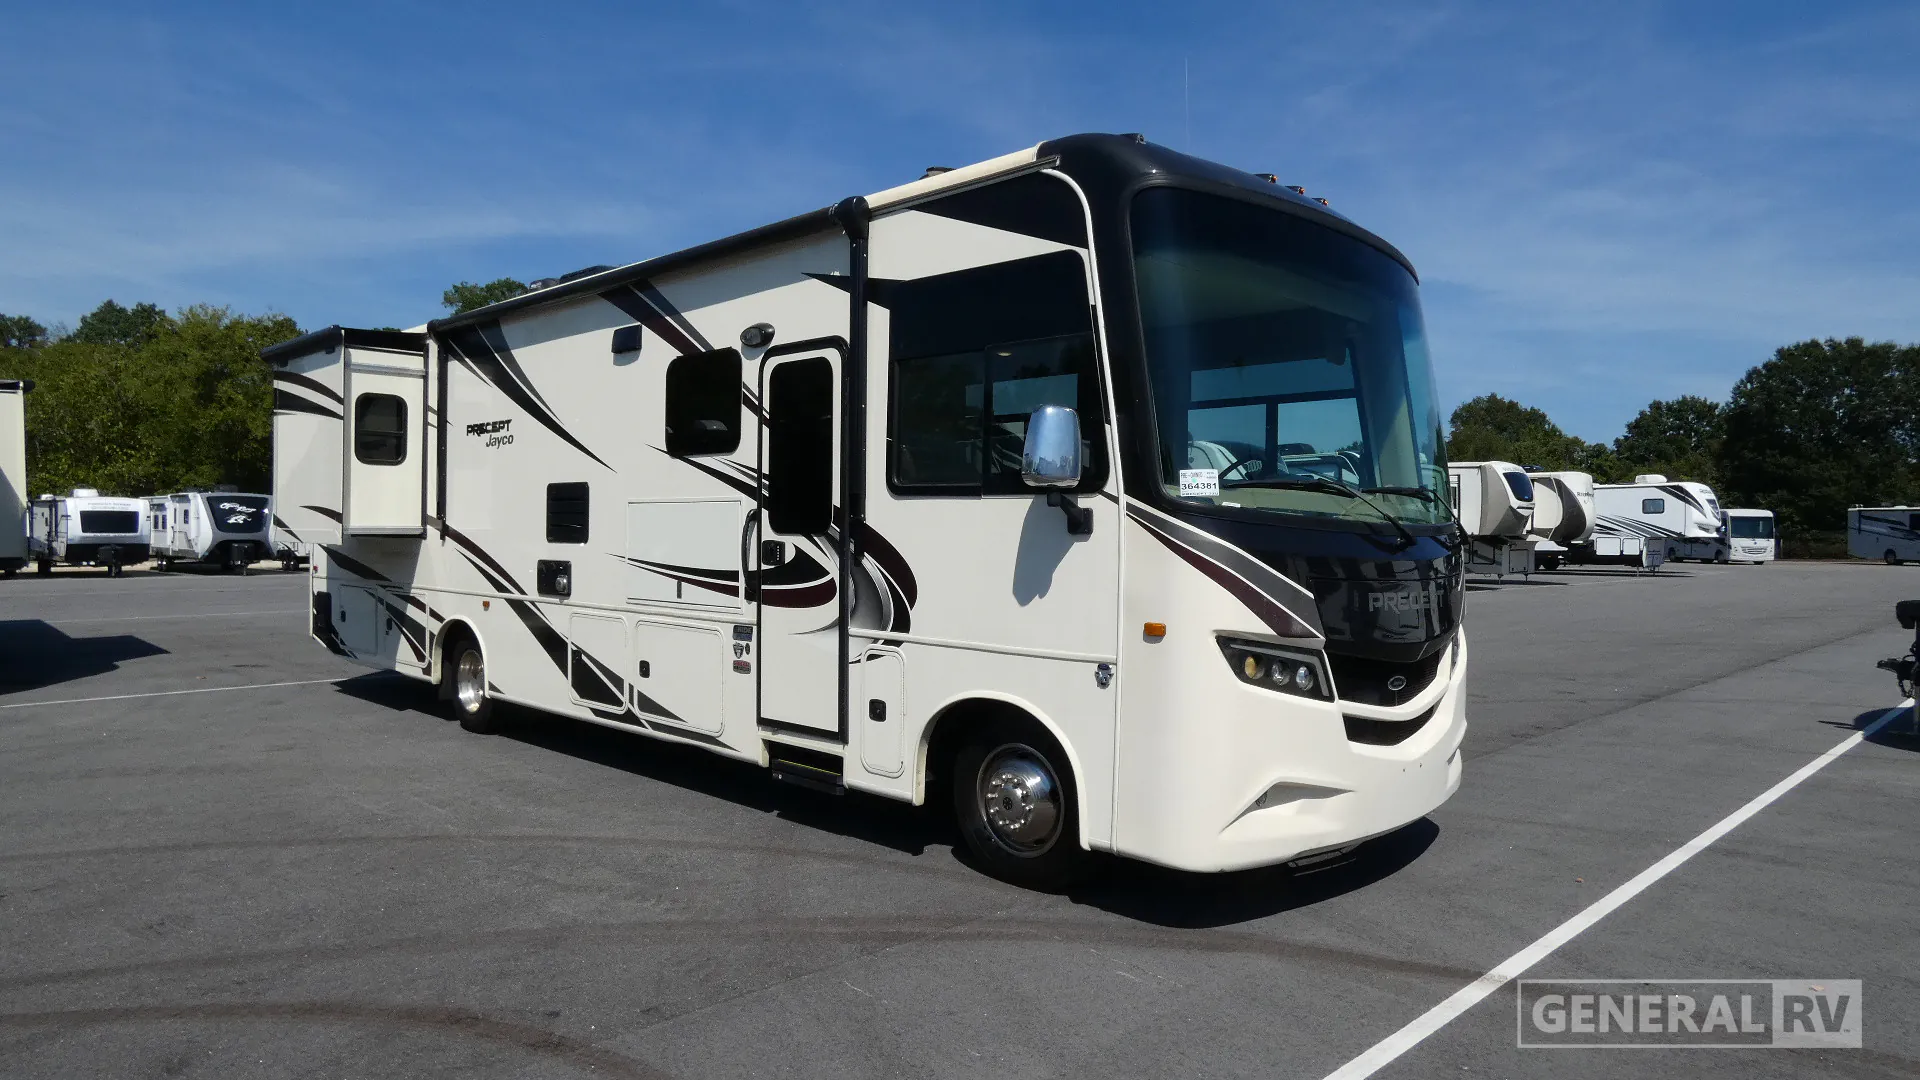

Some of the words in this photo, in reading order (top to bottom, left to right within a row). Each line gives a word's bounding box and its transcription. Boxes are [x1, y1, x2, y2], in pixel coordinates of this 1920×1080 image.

[466, 419, 513, 437] PRECEPT
[485, 434, 514, 450] Jayco
[1181, 482, 1217, 490] 364381
[1368, 589, 1444, 614] PRECET
